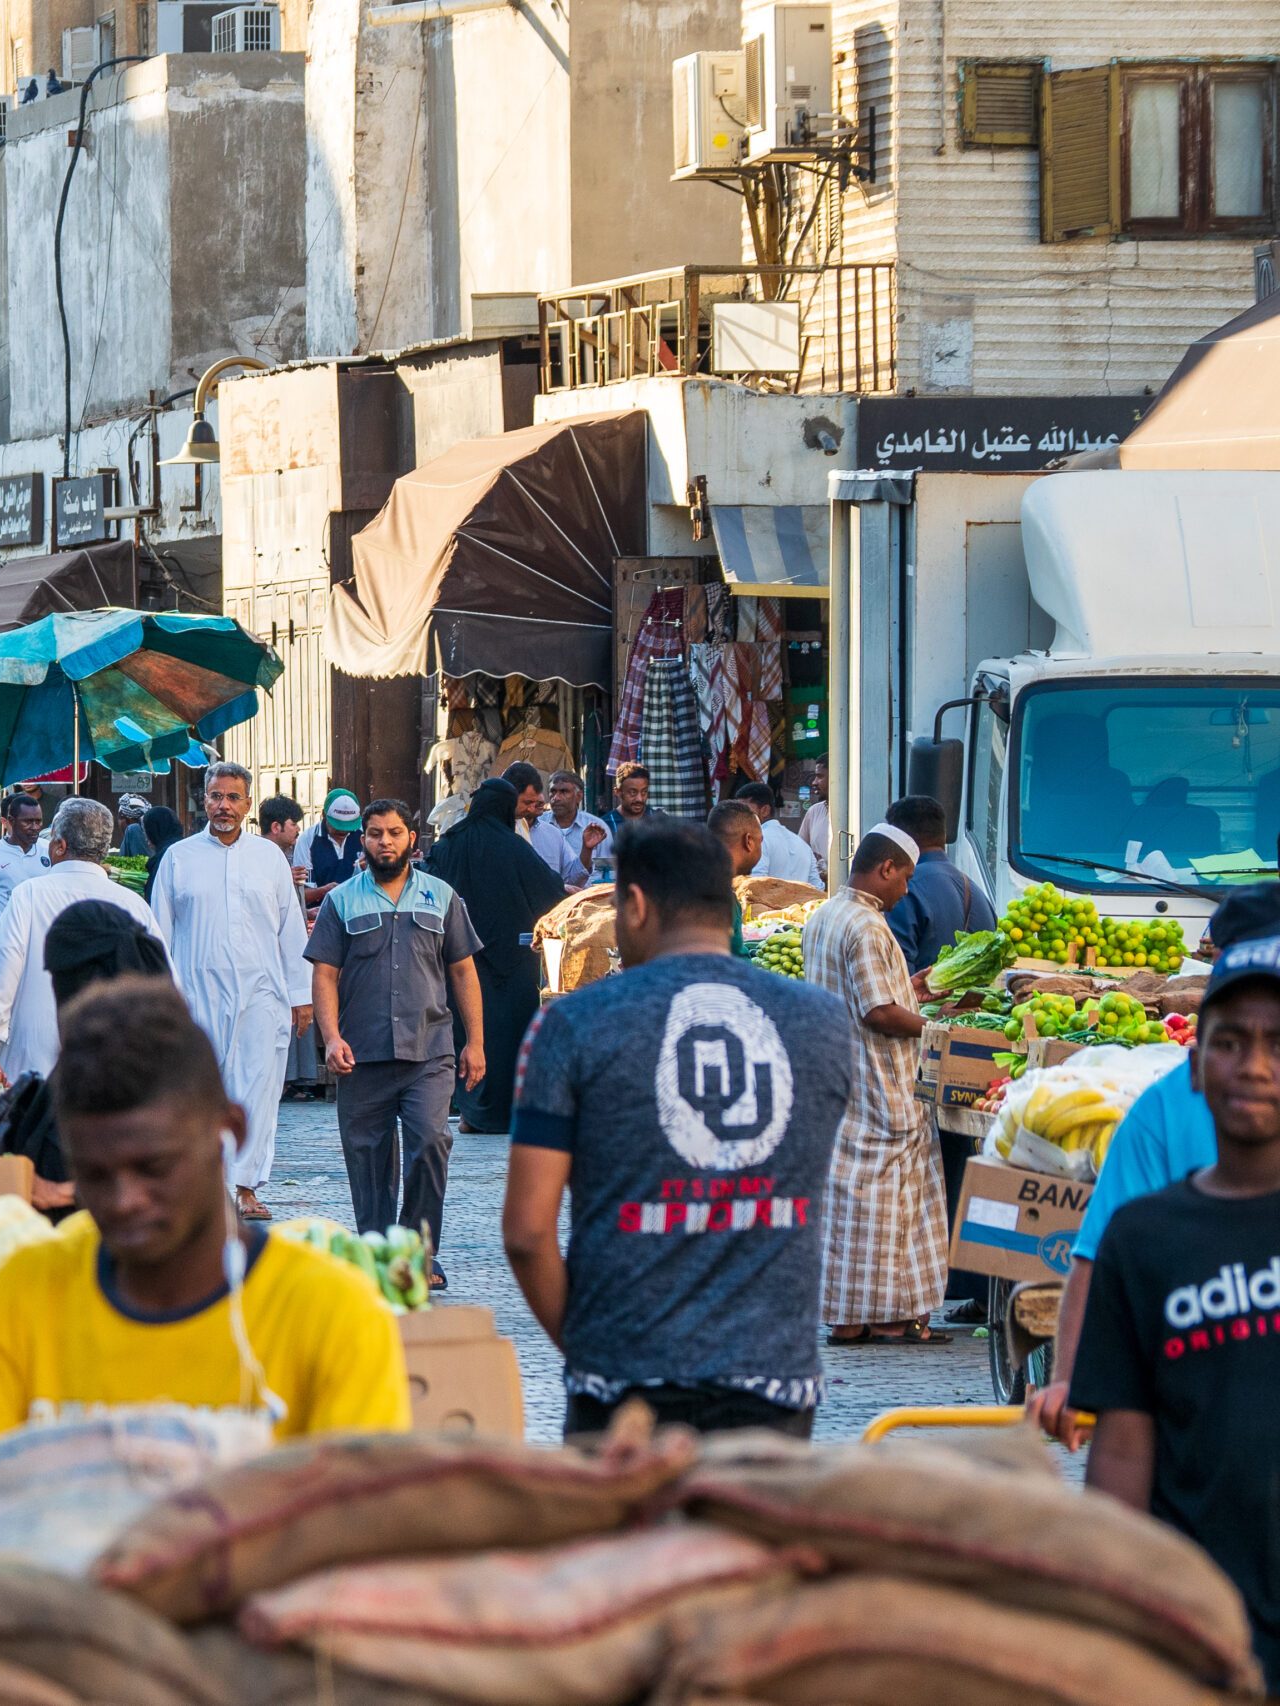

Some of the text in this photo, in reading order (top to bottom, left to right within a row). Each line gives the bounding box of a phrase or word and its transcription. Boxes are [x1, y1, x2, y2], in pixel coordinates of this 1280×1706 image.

[875, 427, 966, 465] الغامدي
[971, 426, 1032, 461] عقيل
[62, 486, 97, 516] باب مكة
[738, 1175, 777, 1196] MY
